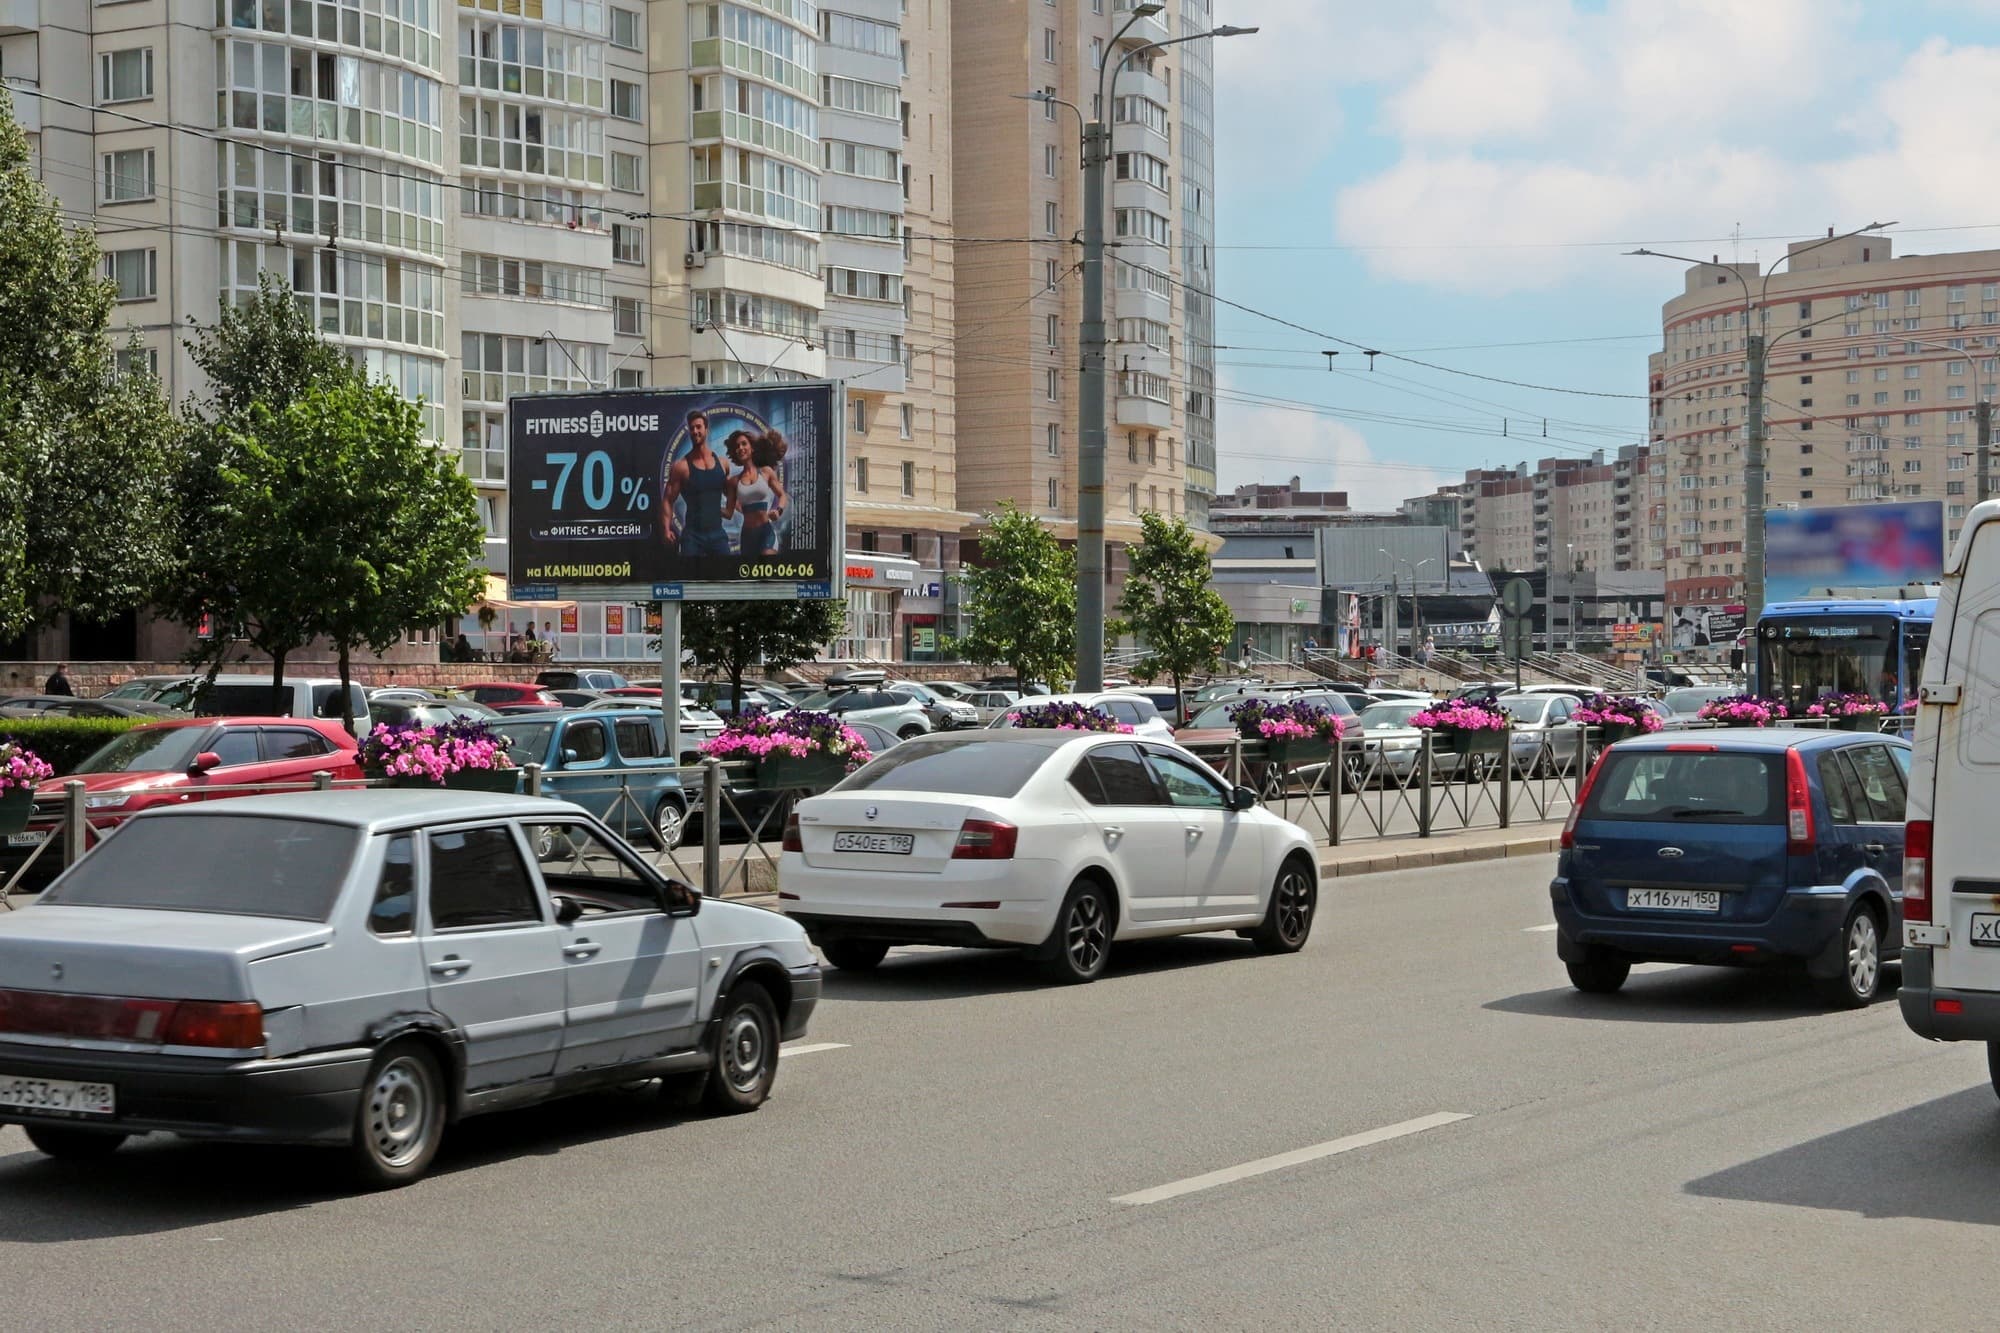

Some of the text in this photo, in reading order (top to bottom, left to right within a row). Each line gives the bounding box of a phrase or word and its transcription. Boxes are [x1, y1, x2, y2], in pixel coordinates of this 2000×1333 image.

[526, 415, 659, 435] FITNESS HOUSE
[551, 525, 589, 536] ФИТНЕС
[598, 523, 641, 535] БАССЕЙН
[527, 561, 631, 577] на КАМЫШОВОЙ
[1785, 627, 1791, 638] 2
